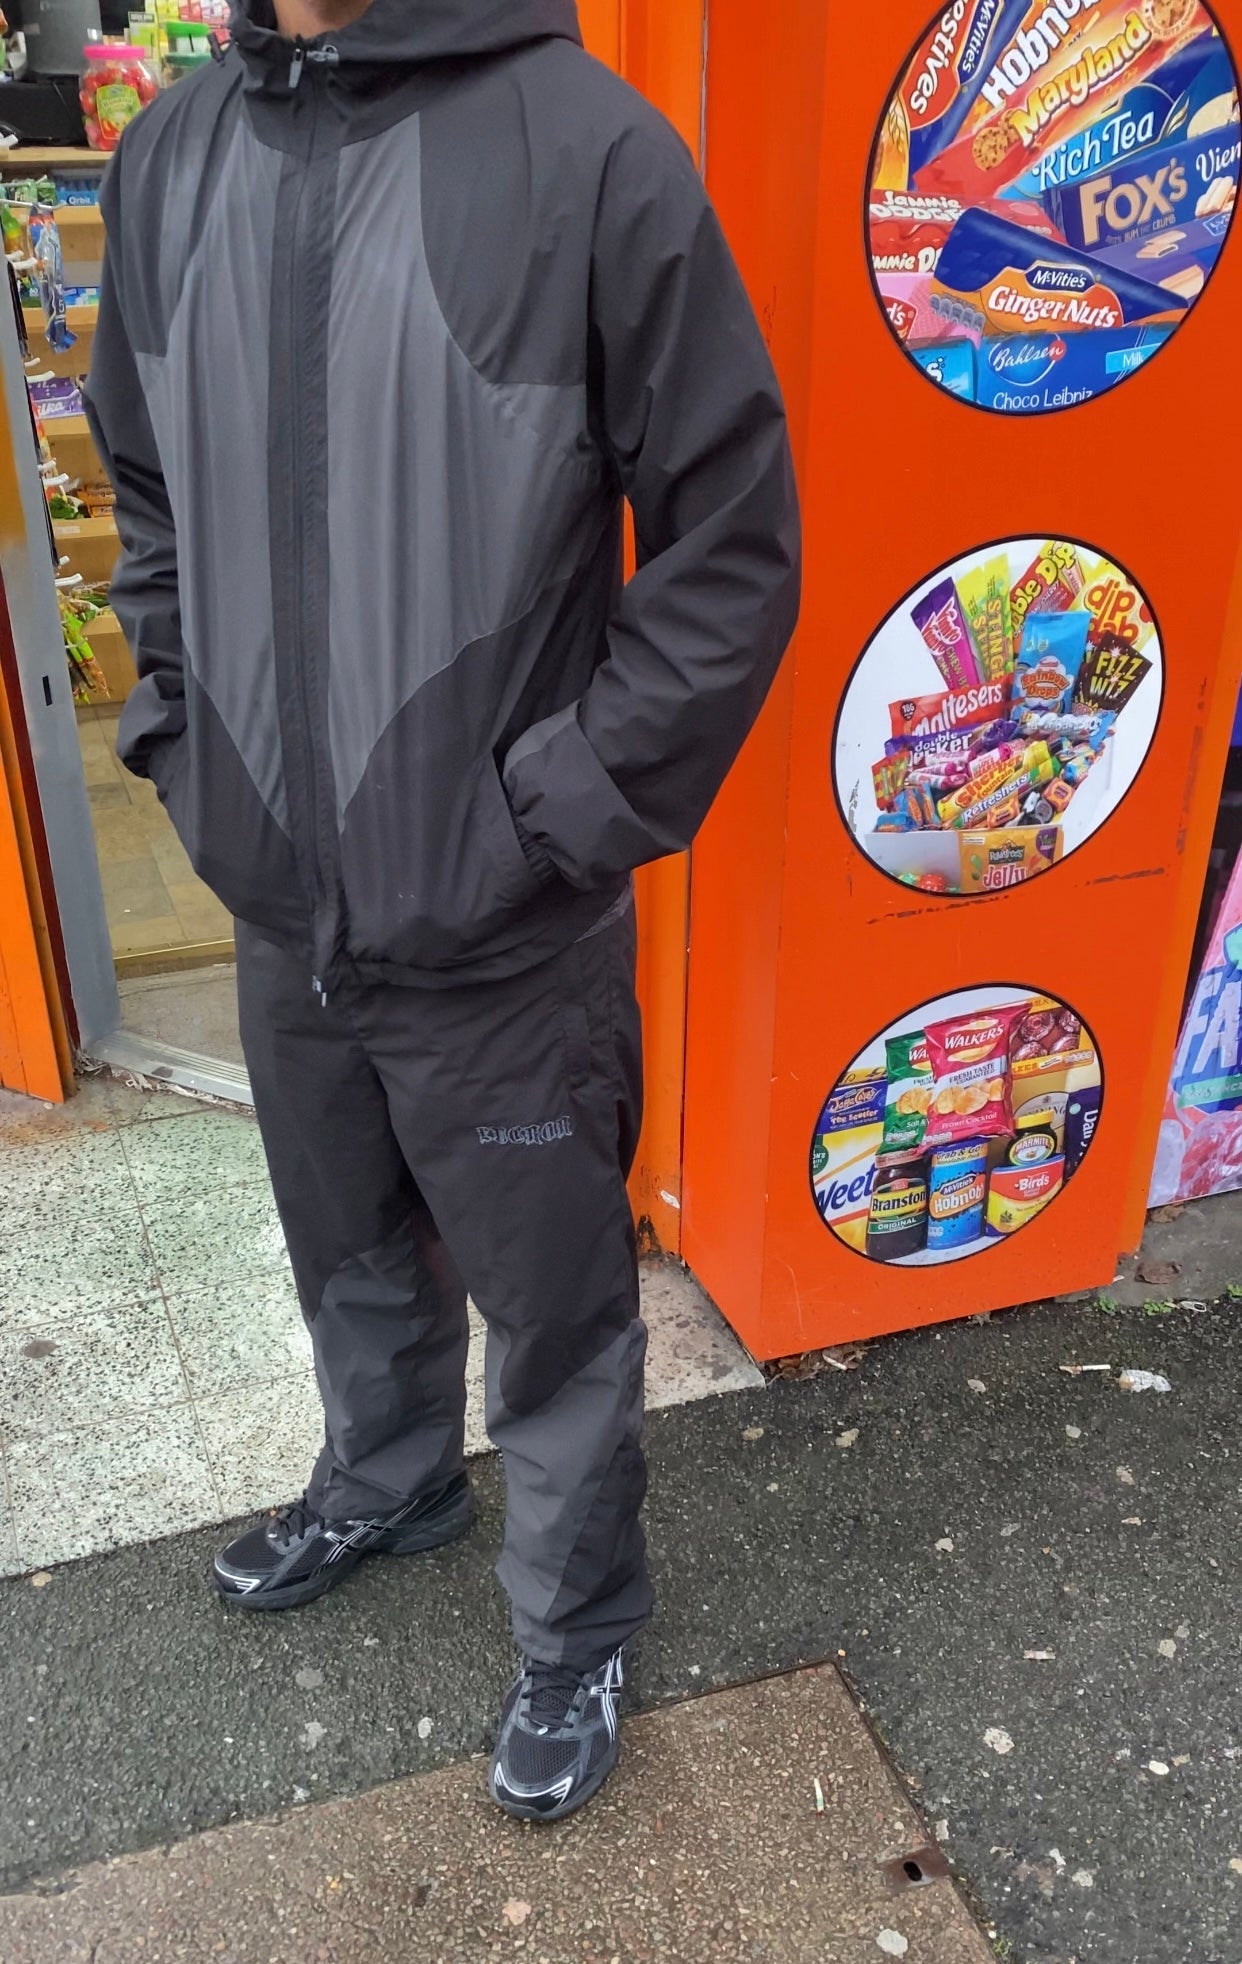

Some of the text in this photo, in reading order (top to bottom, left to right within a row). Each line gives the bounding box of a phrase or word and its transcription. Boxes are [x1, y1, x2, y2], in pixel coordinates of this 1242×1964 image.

[911, 0, 969, 115] estives
[1007, 9, 1153, 149] Maryland
[1031, 111, 1155, 192] Rich Tea
[1031, 270, 1087, 289] McVitie's
[987, 285, 1119, 328] Ginger Nuts
[992, 340, 1065, 372] Bahlsen
[993, 391, 1040, 411] Choco
[962, 772, 1029, 824] Refreshers
[945, 1024, 1005, 1050] WALKERS
[909, 1048, 931, 1061] WA
[949, 1070, 974, 1084] FRESH
[872, 1190, 927, 1212] Branston
